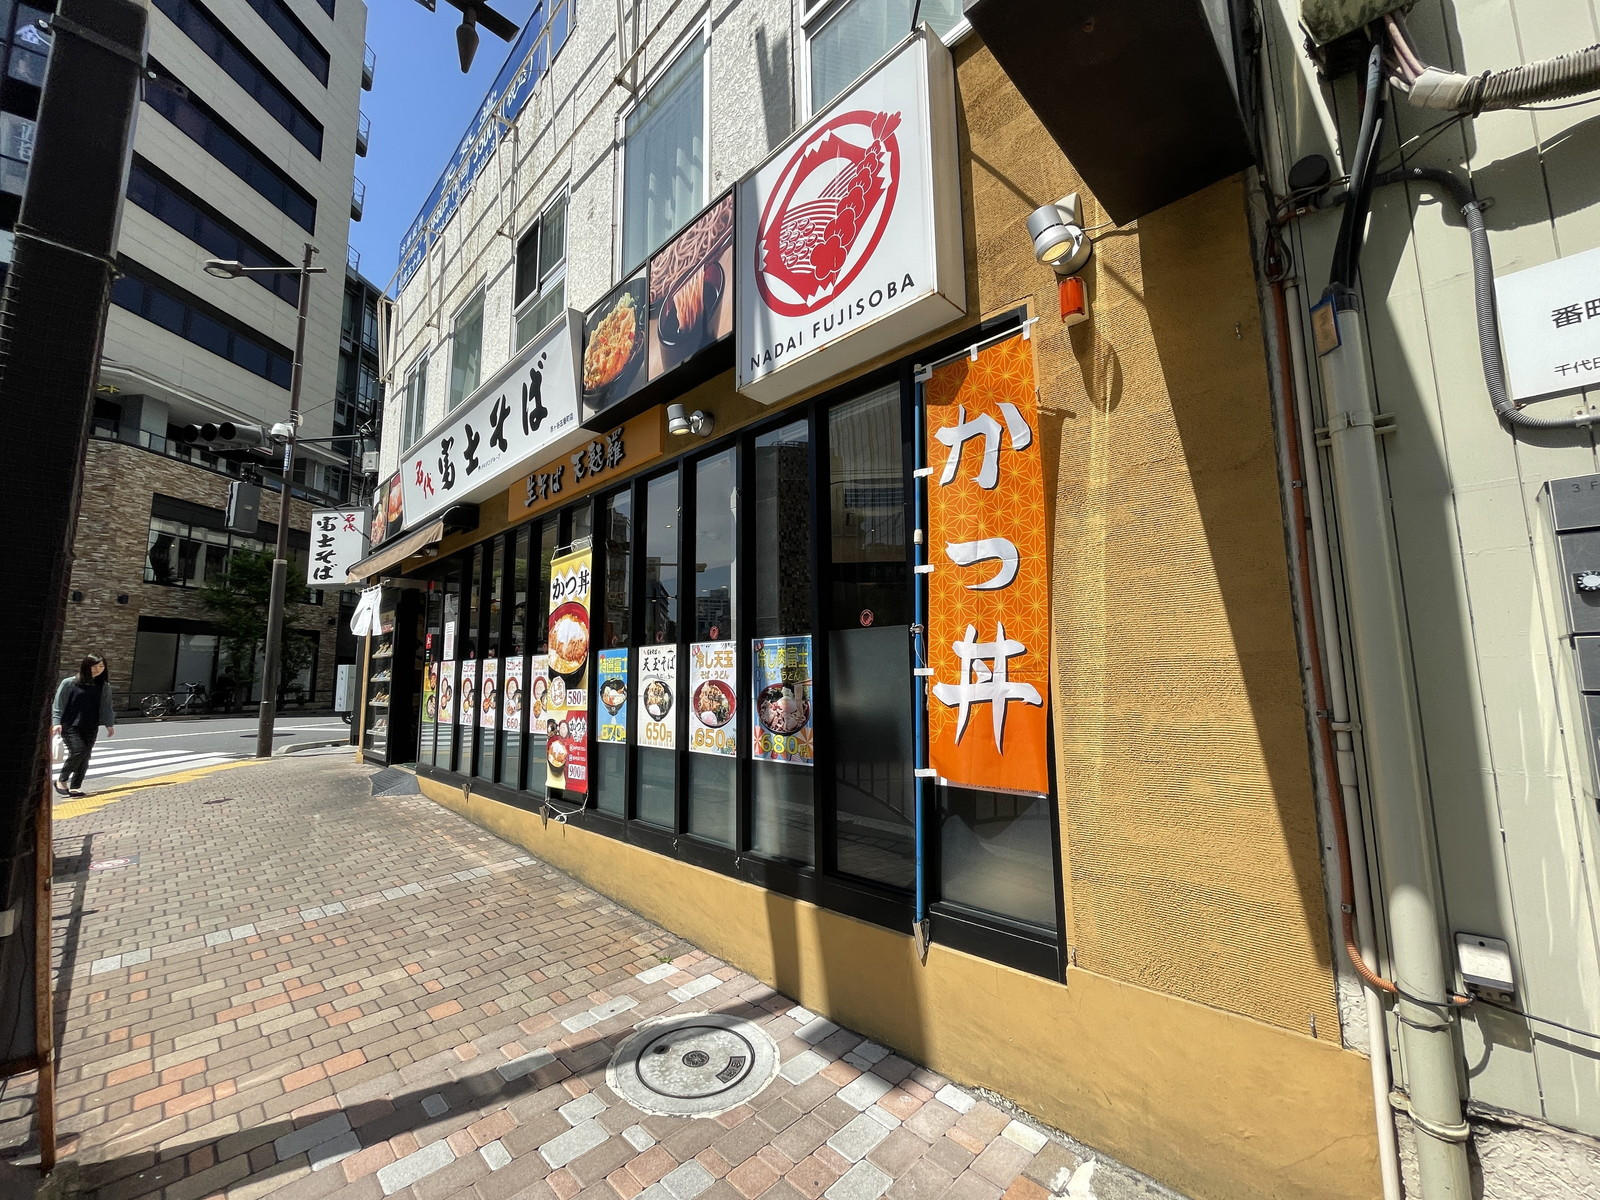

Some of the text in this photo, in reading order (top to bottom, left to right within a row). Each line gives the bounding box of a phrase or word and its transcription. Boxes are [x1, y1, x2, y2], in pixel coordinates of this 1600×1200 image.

[750, 272, 916, 371] NADAI FUJISOBA
[552, 569, 590, 601] かつ丼
[933, 402, 1043, 755] かつ丼
[642, 655, 676, 671] 天玉そば
[695, 650, 734, 669] 冷し天玉
[756, 646, 808, 668] 冷し肉富士
[646, 722, 672, 742] 650円
[695, 728, 735, 750] 650円
[761, 735, 809, 758] 680円
